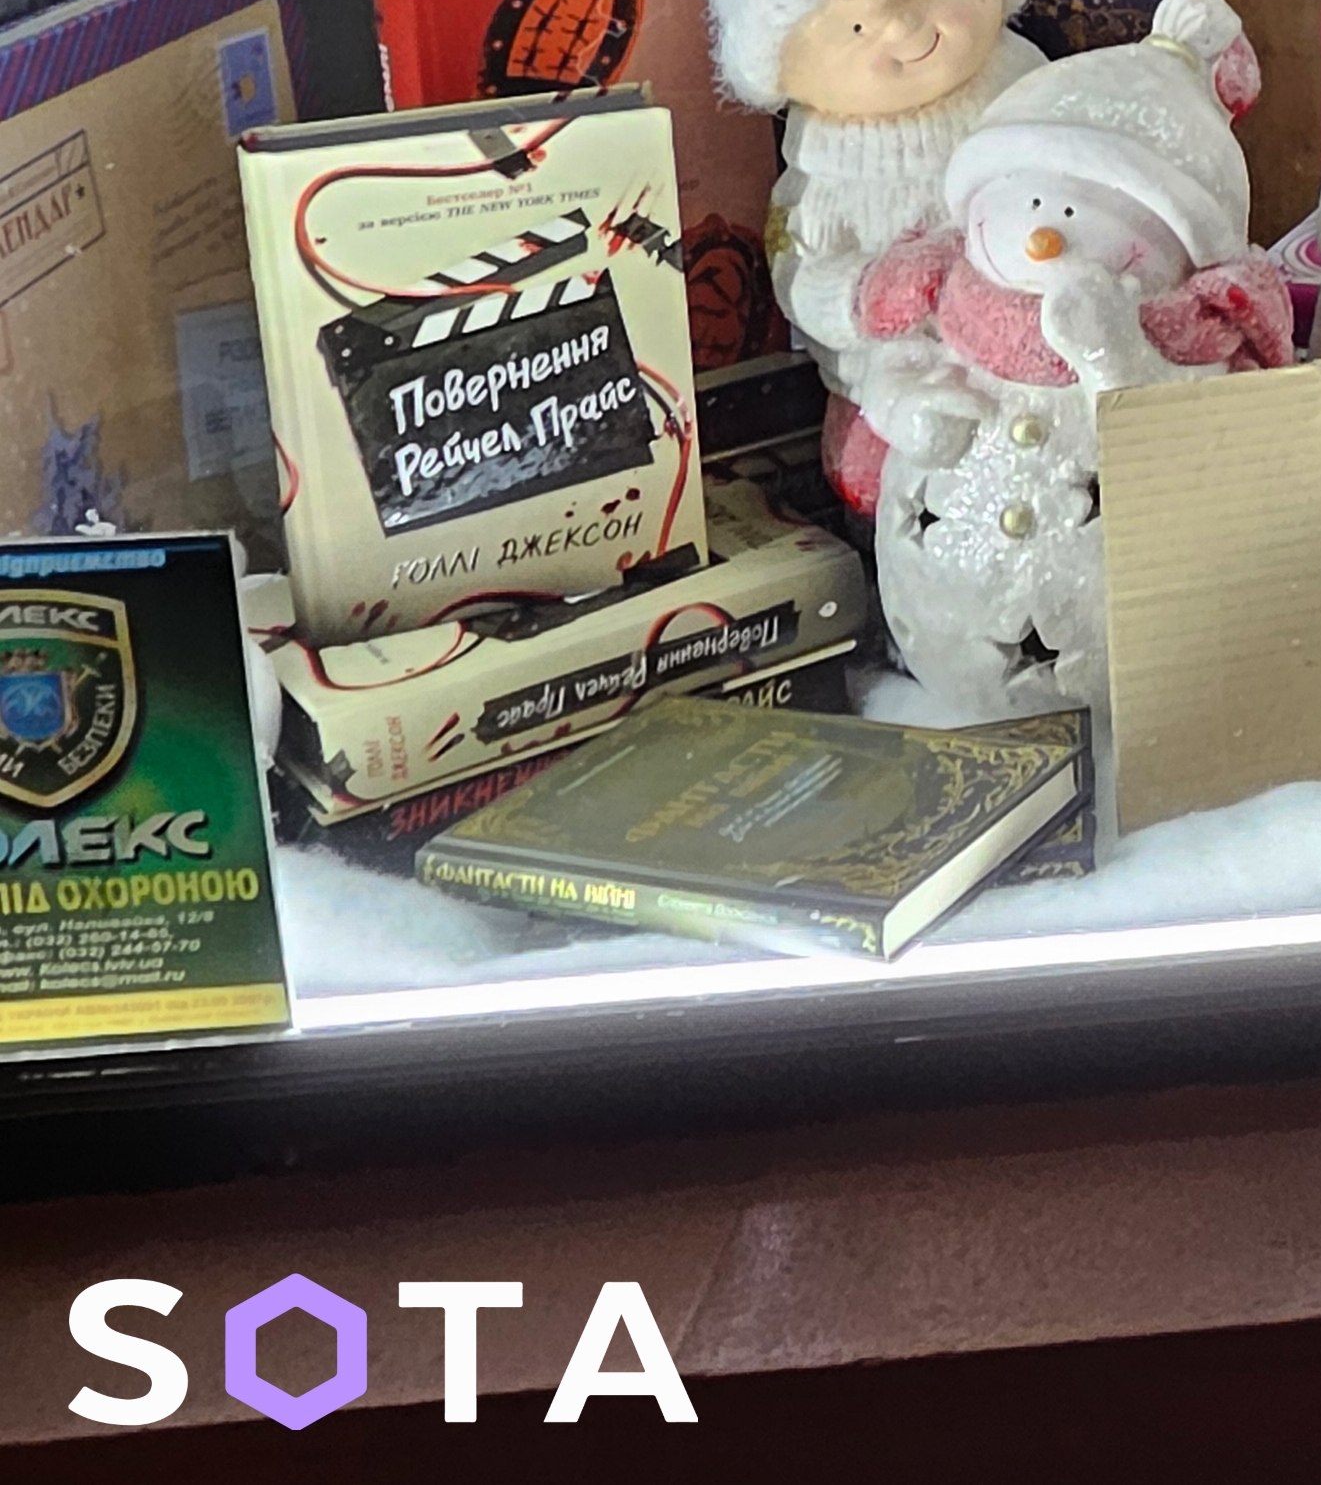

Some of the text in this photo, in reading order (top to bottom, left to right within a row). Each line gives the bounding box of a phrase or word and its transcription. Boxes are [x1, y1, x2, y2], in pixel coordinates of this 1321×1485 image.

[479, 199, 512, 215] NEW
[516, 193, 554, 210] YORK
[559, 187, 601, 203] TIMES
[389, 325, 610, 434] Повернення
[394, 375, 638, 497] Рейчел Прайс
[497, 511, 644, 569] ДЖЕКСОН
[656, 615, 780, 676] Повернення
[0, 808, 211, 866] ЛЕКС
[57, 867, 260, 912] ОХОРОНОЮ
[436, 863, 545, 896] ФАНТАСТИ
[550, 877, 578, 901] НА
